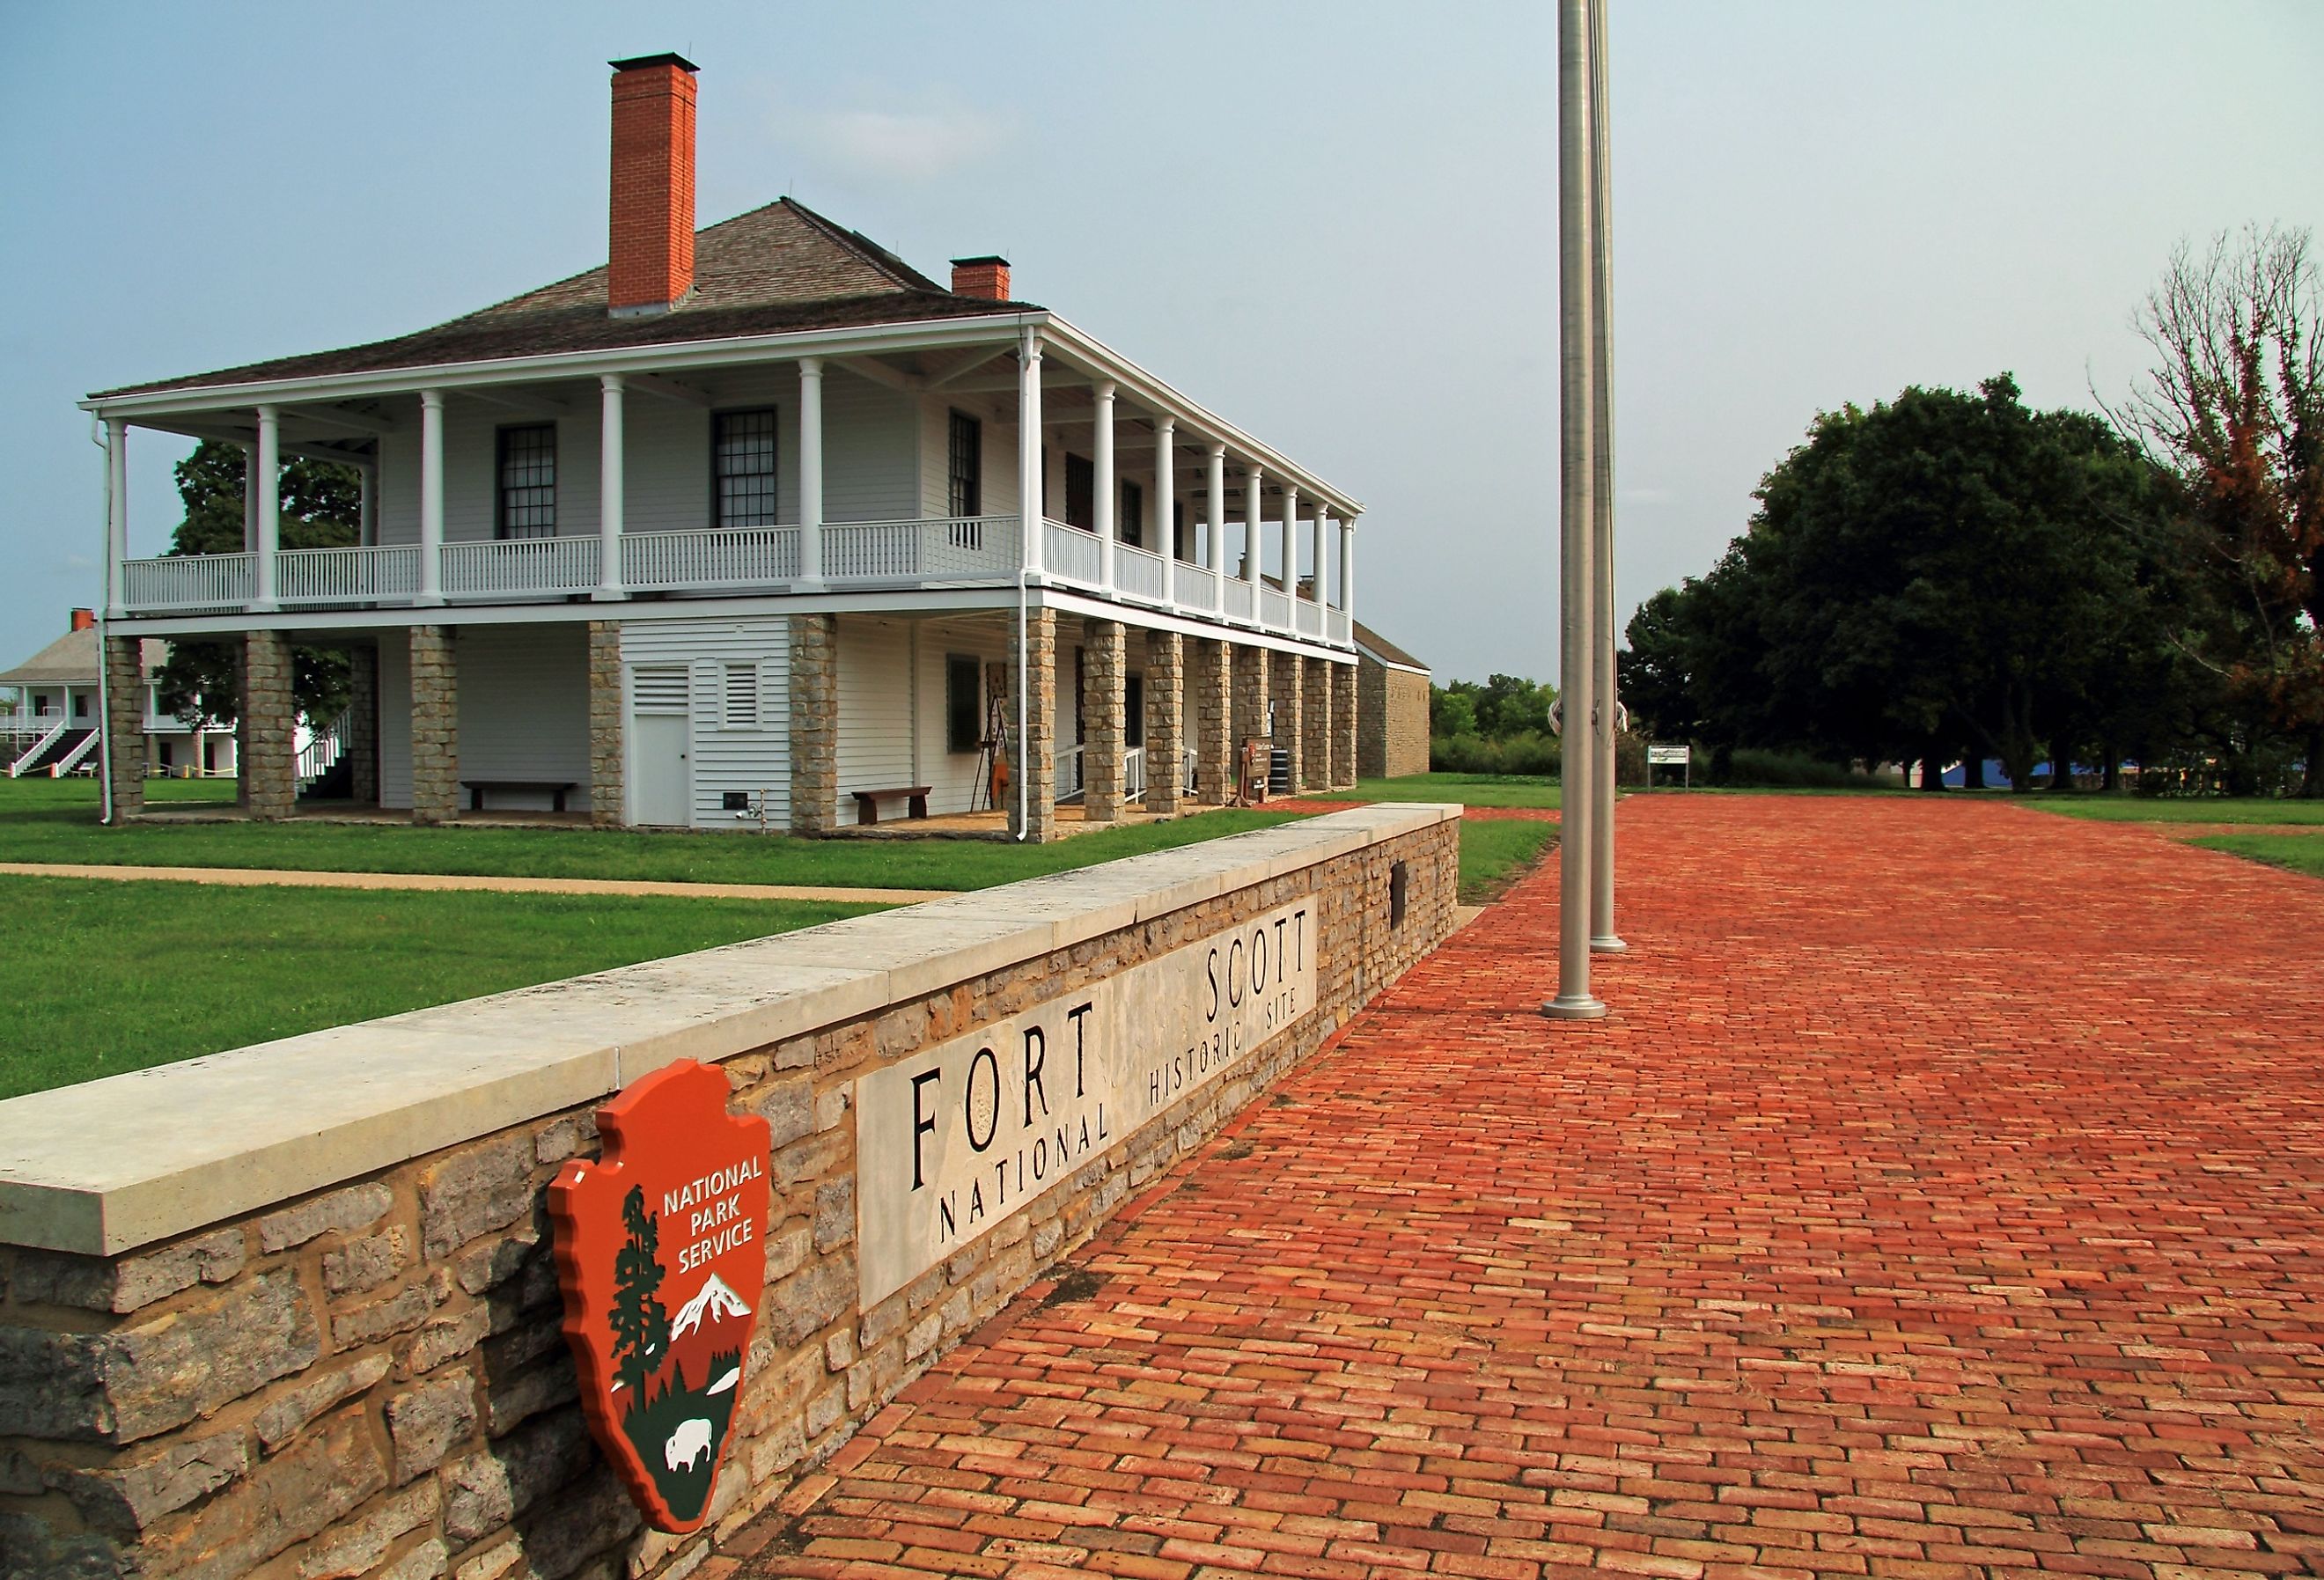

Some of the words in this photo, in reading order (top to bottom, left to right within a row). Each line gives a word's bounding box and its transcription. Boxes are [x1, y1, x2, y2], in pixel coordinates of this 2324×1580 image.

[910, 1002, 1092, 1191] FORT
[1206, 909, 1305, 1023] SCOTT
[939, 1102, 1108, 1244] NATIONAL
[1150, 1021, 1241, 1106] HISTORIC
[1267, 987, 1296, 1030] SITE
[664, 1155, 762, 1216] NATIONAL
[691, 1193, 740, 1237] PARK
[678, 1217, 753, 1274] SERVICE
